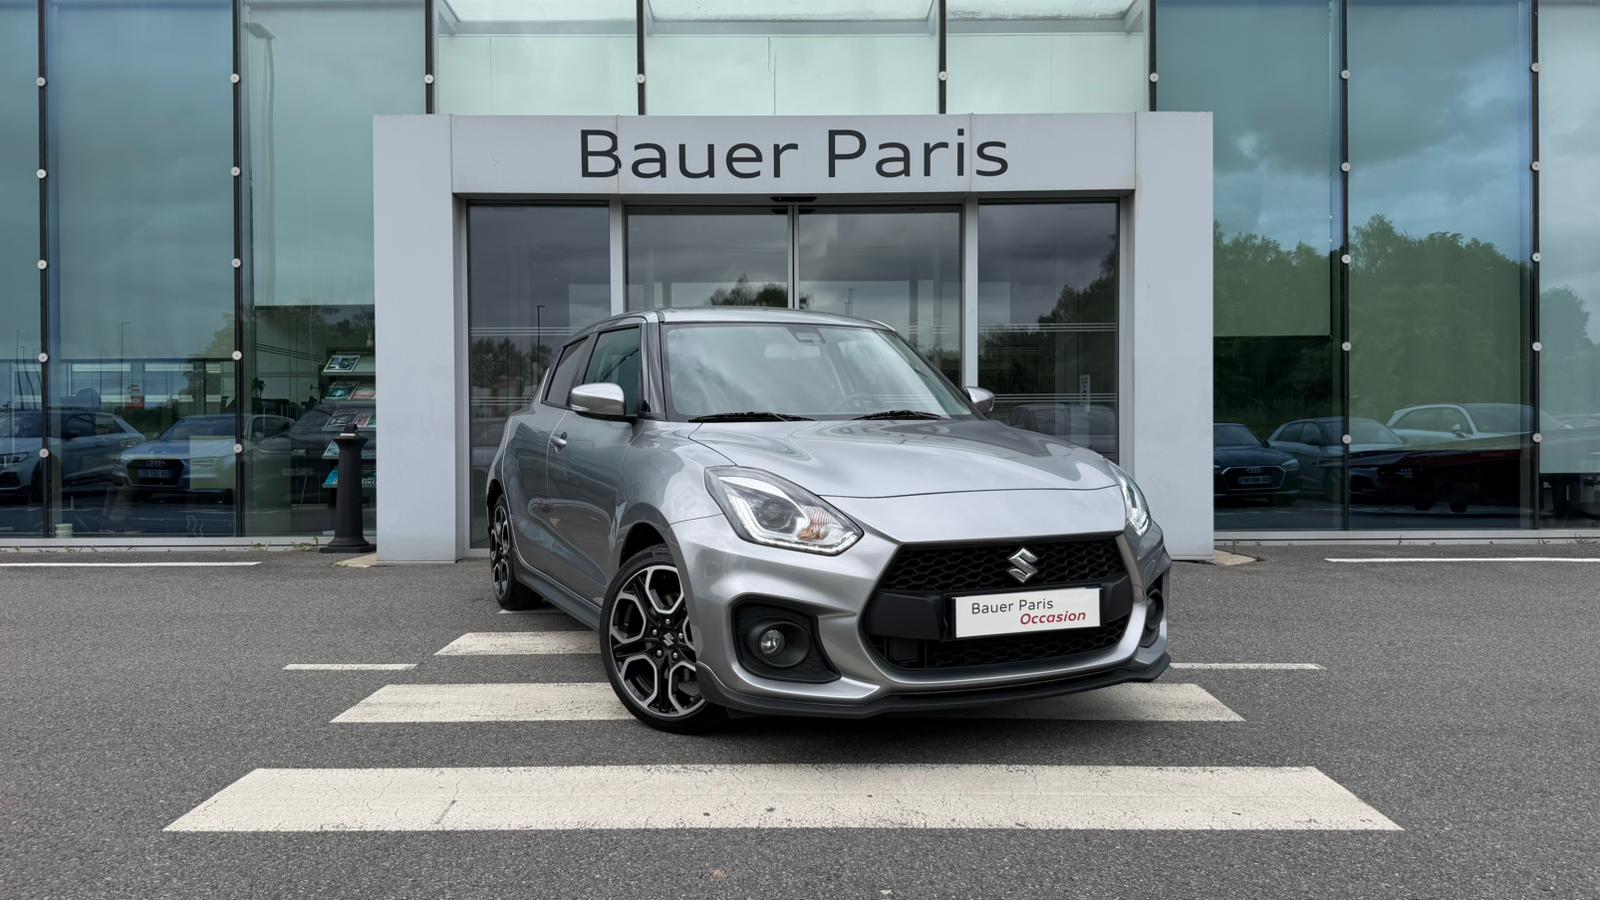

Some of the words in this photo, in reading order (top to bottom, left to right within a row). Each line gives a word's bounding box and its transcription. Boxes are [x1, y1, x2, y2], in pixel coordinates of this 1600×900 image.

[580, 129, 799, 178] Bauer
[828, 128, 1009, 178] Paris
[971, 602, 1014, 615] Bauer
[1018, 598, 1054, 611] Paris
[1020, 610, 1087, 625] Occasion
